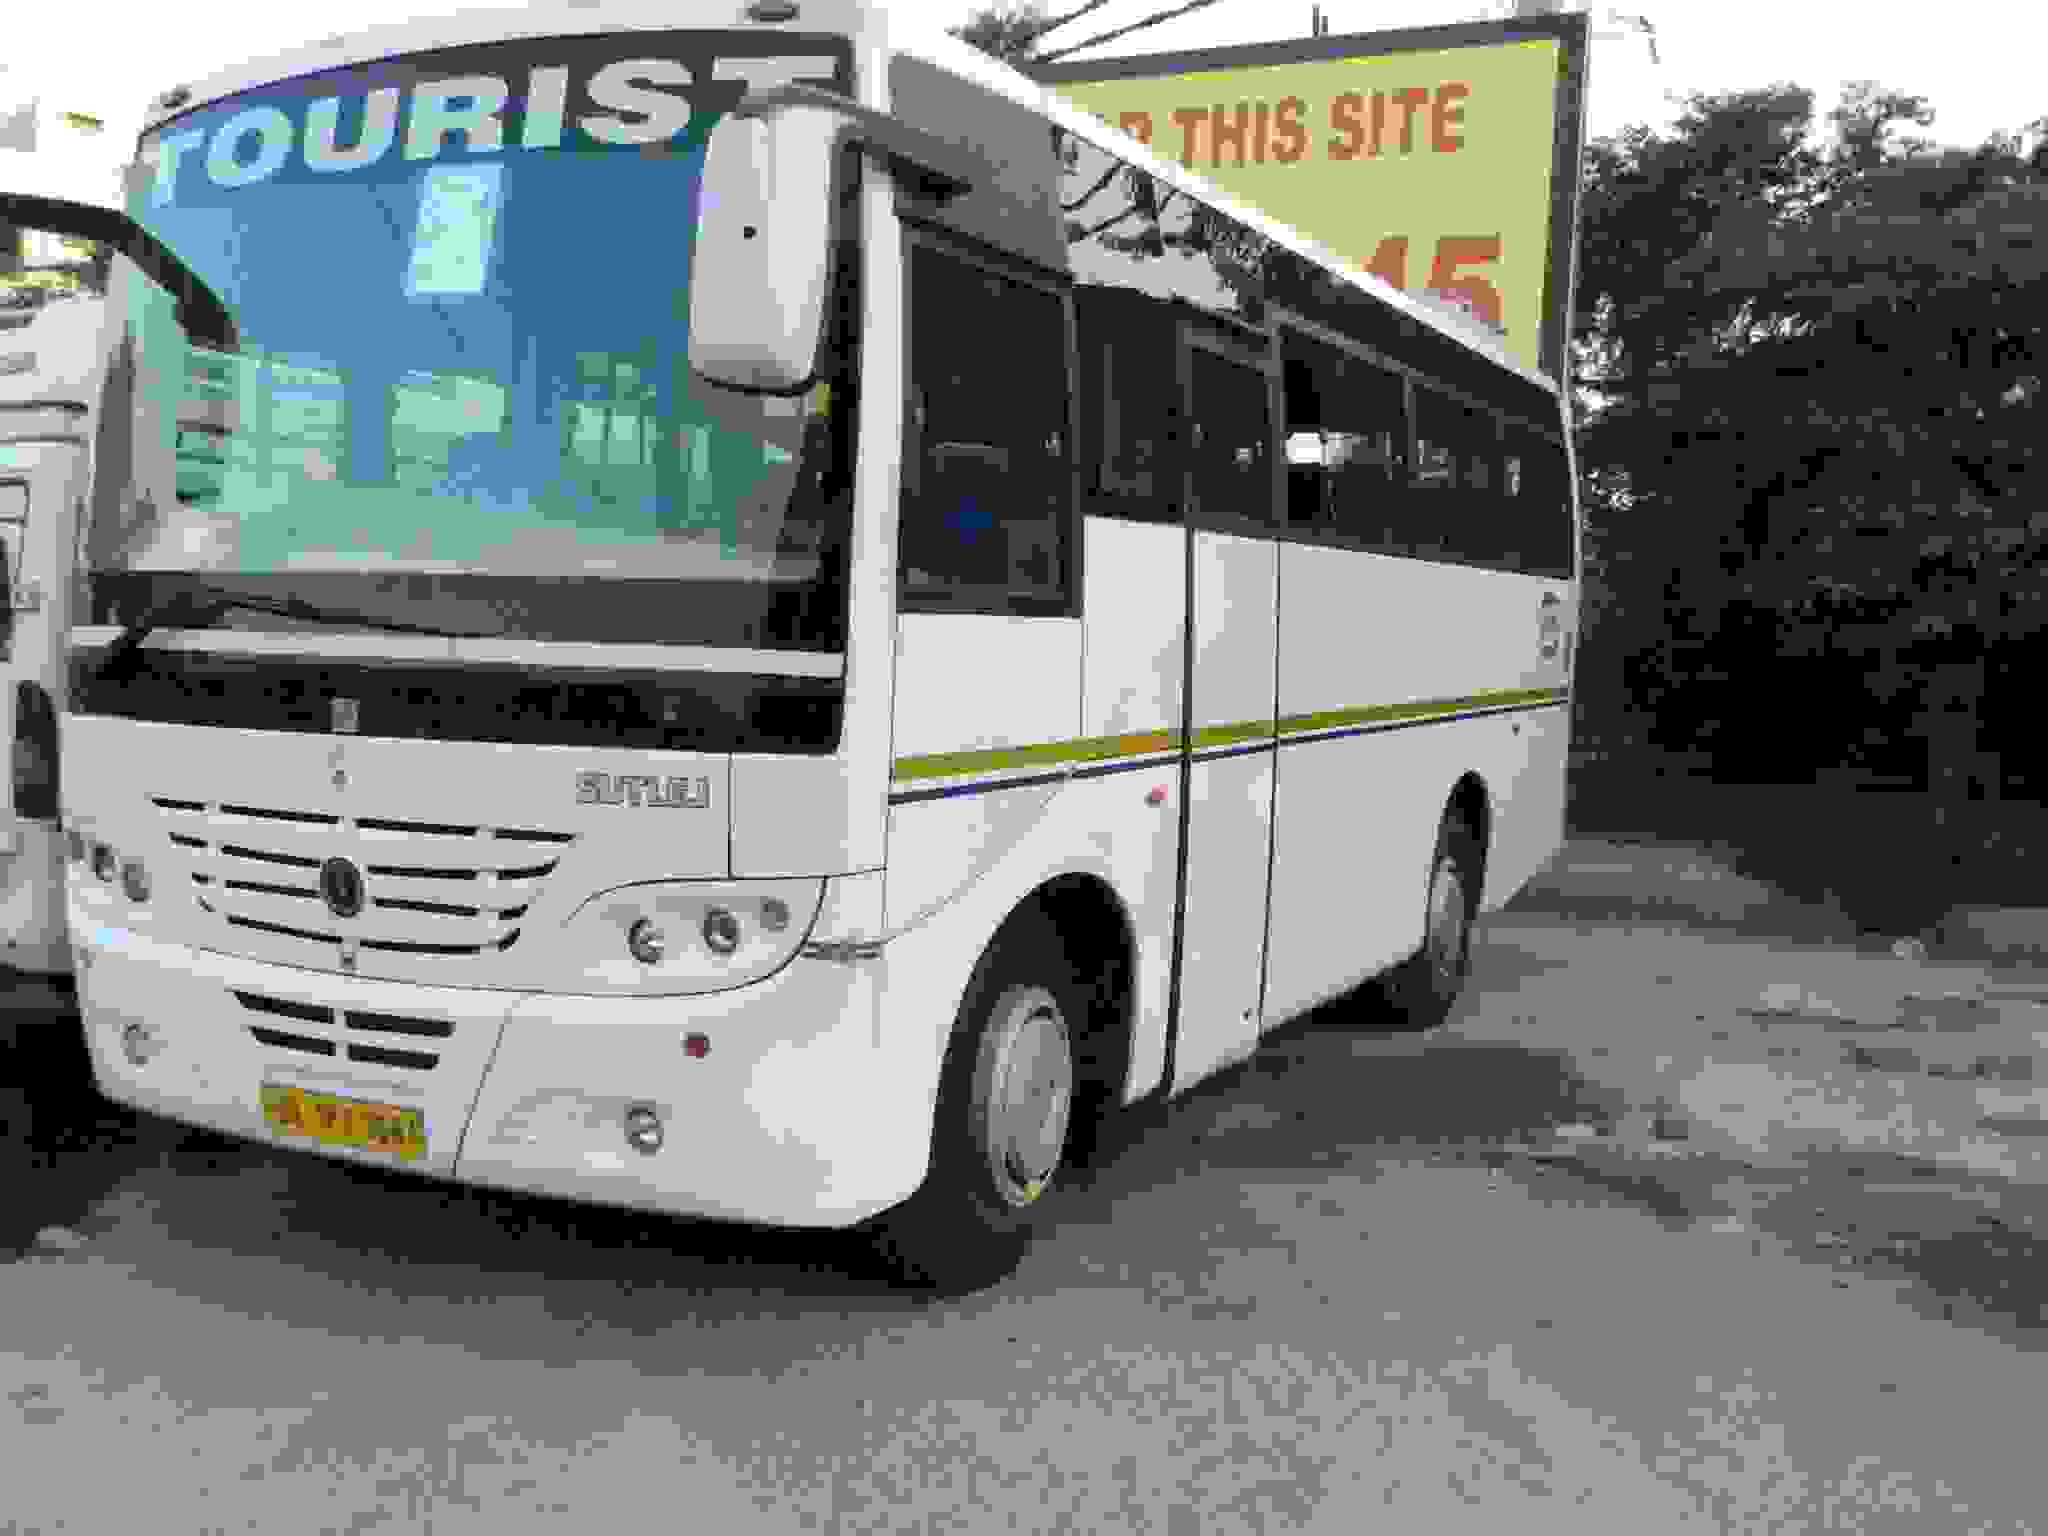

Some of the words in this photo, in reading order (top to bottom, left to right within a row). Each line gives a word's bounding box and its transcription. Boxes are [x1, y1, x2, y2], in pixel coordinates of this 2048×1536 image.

[152, 56, 838, 208] TOURIST
[1170, 97, 1311, 167] THIS
[1328, 80, 1471, 160] SITE
